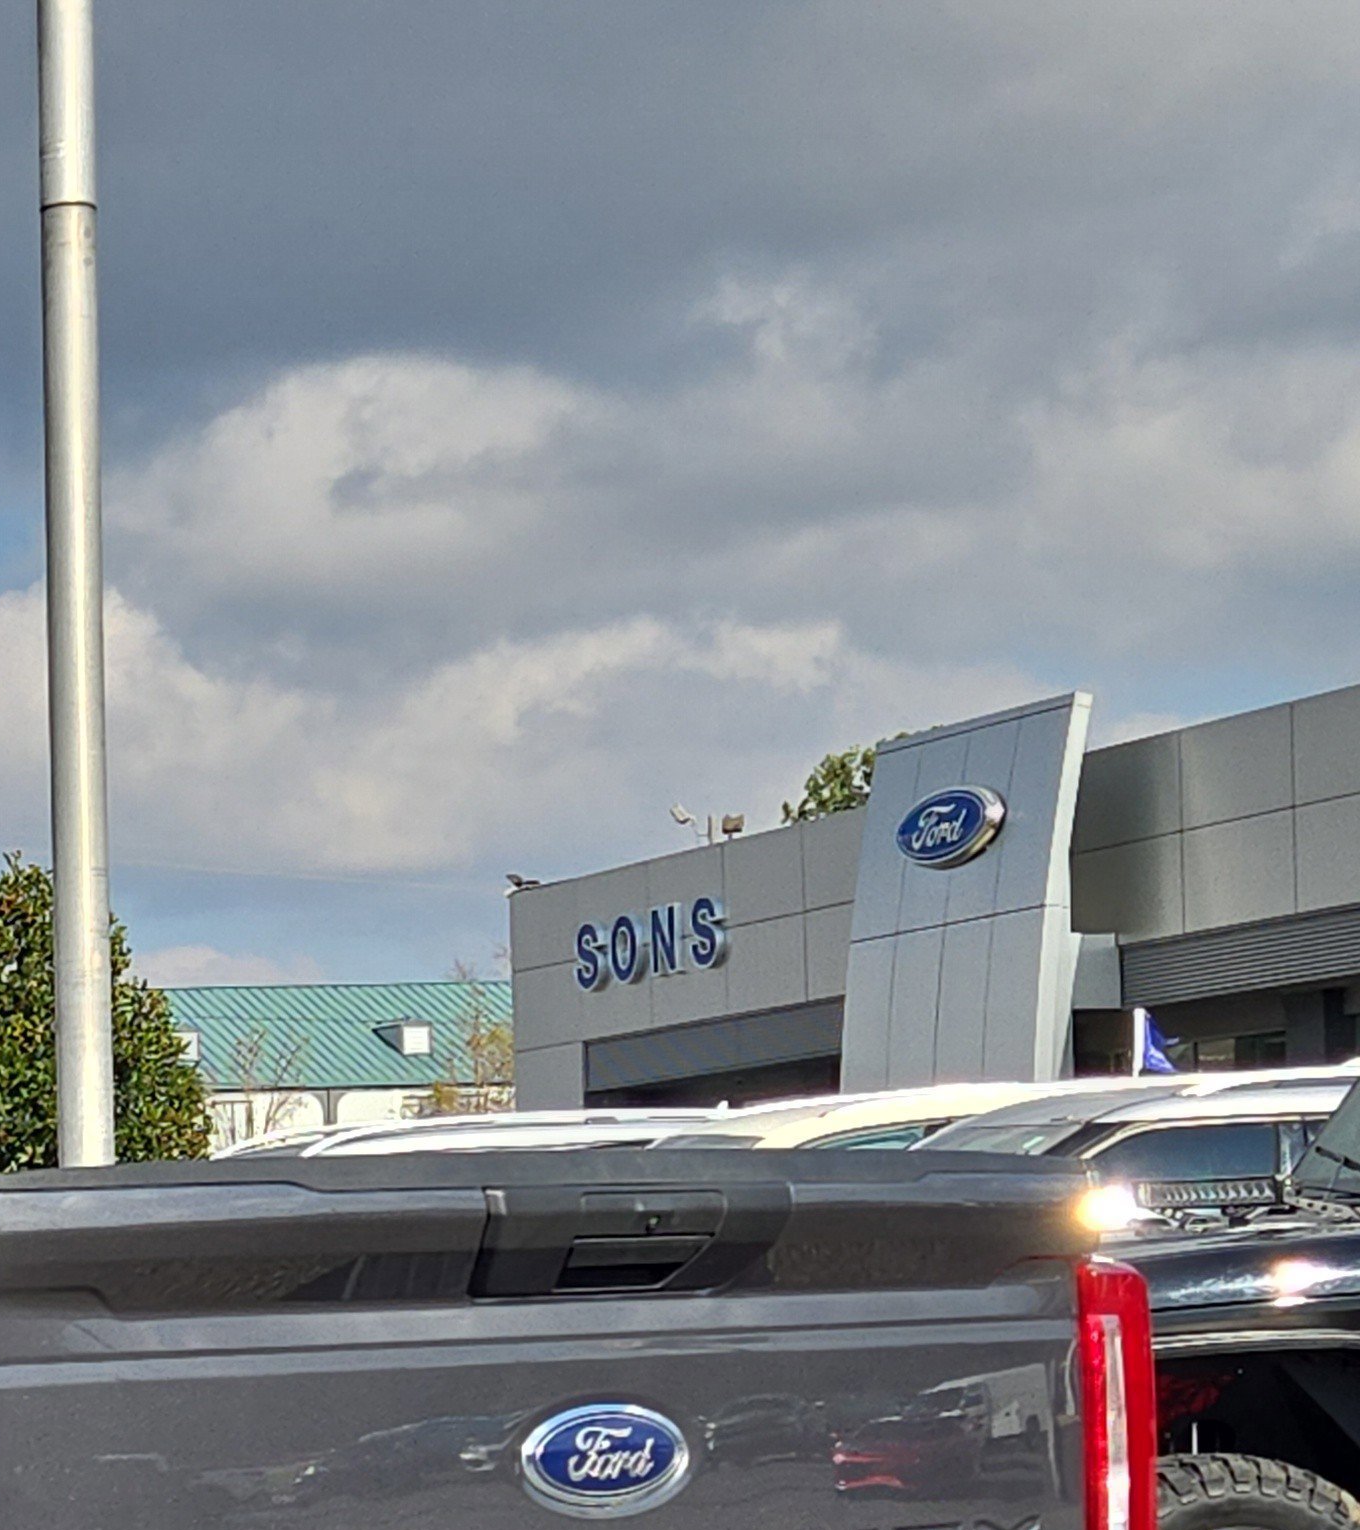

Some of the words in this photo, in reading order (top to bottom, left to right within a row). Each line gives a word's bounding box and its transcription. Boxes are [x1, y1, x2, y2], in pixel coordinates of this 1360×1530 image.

[910, 802, 966, 850] Ford
[576, 896, 726, 990] SONS
[567, 1426, 656, 1482] Ford
